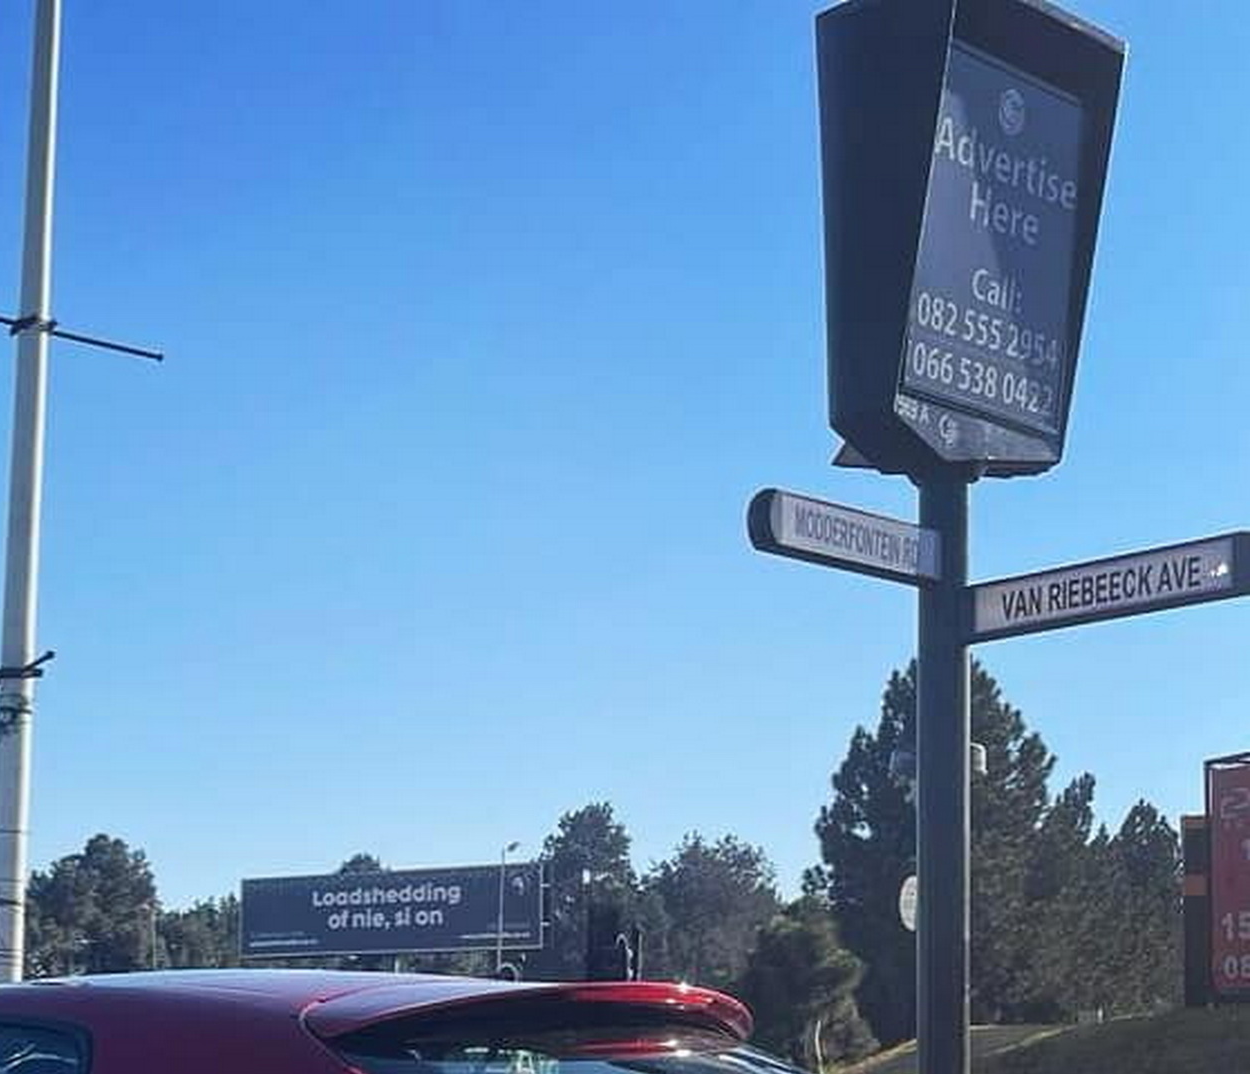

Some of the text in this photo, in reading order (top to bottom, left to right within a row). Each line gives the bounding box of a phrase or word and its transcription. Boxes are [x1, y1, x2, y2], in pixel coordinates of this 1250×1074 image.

[934, 115, 1078, 210] Advertise
[969, 180, 1040, 245] Here
[972, 267, 1023, 313] Call:
[917, 291, 957, 337] 082
[961, 309, 1002, 351] 555
[912, 342, 954, 386] 066
[958, 358, 998, 399] 538
[793, 502, 902, 564] MODDERFONTEIN
[1001, 556, 1201, 622] VAN RIEBEECK AVE
[312, 883, 462, 907] Loadshedding
[328, 907, 444, 930] of nie, si on
